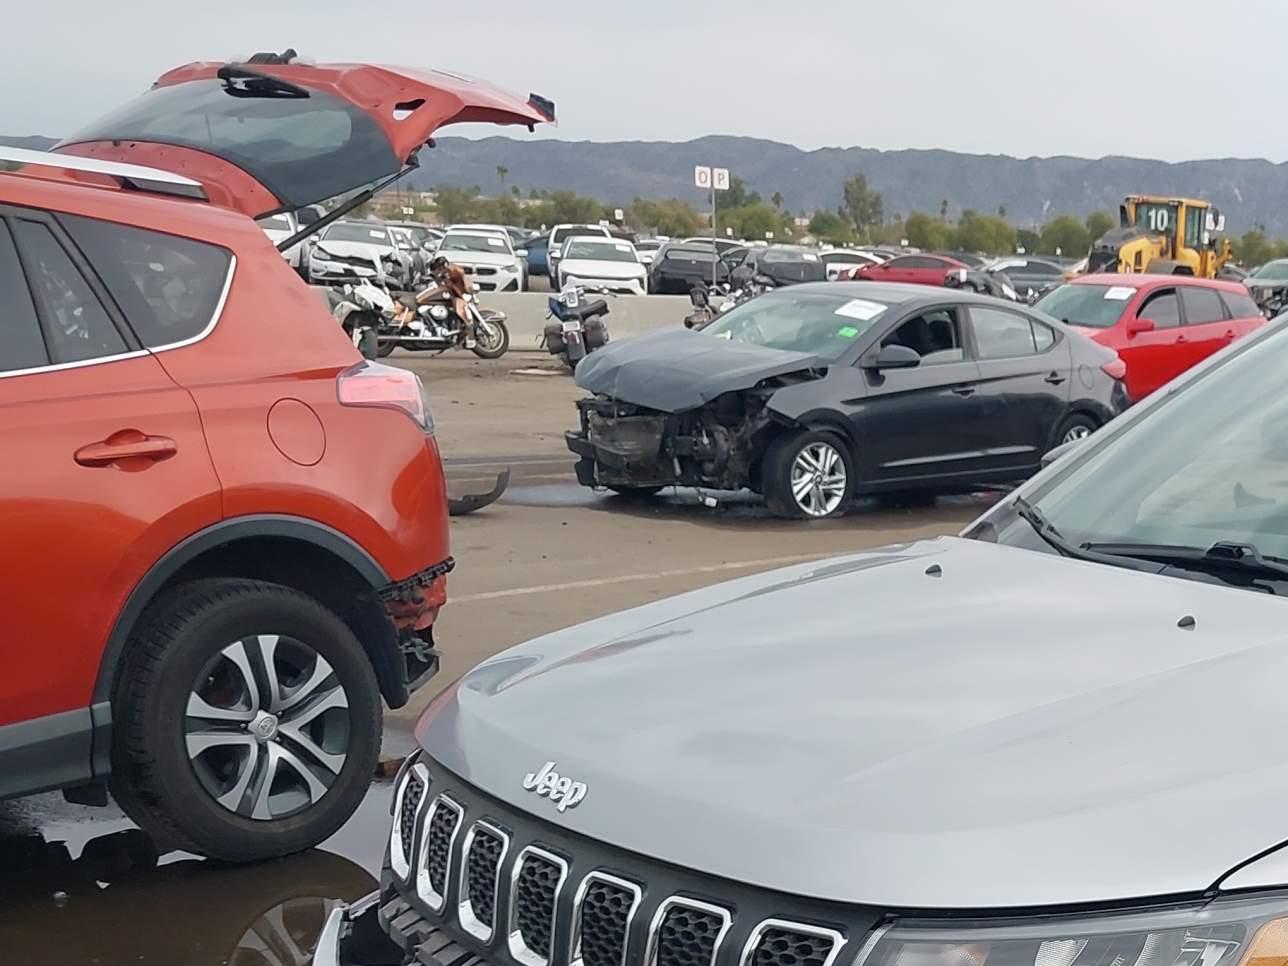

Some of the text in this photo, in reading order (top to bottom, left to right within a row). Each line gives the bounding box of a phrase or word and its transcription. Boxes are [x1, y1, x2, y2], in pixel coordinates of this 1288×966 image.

[717, 172, 726, 185] P
[1147, 207, 1169, 232] 10
[522, 761, 588, 813] Jeep
